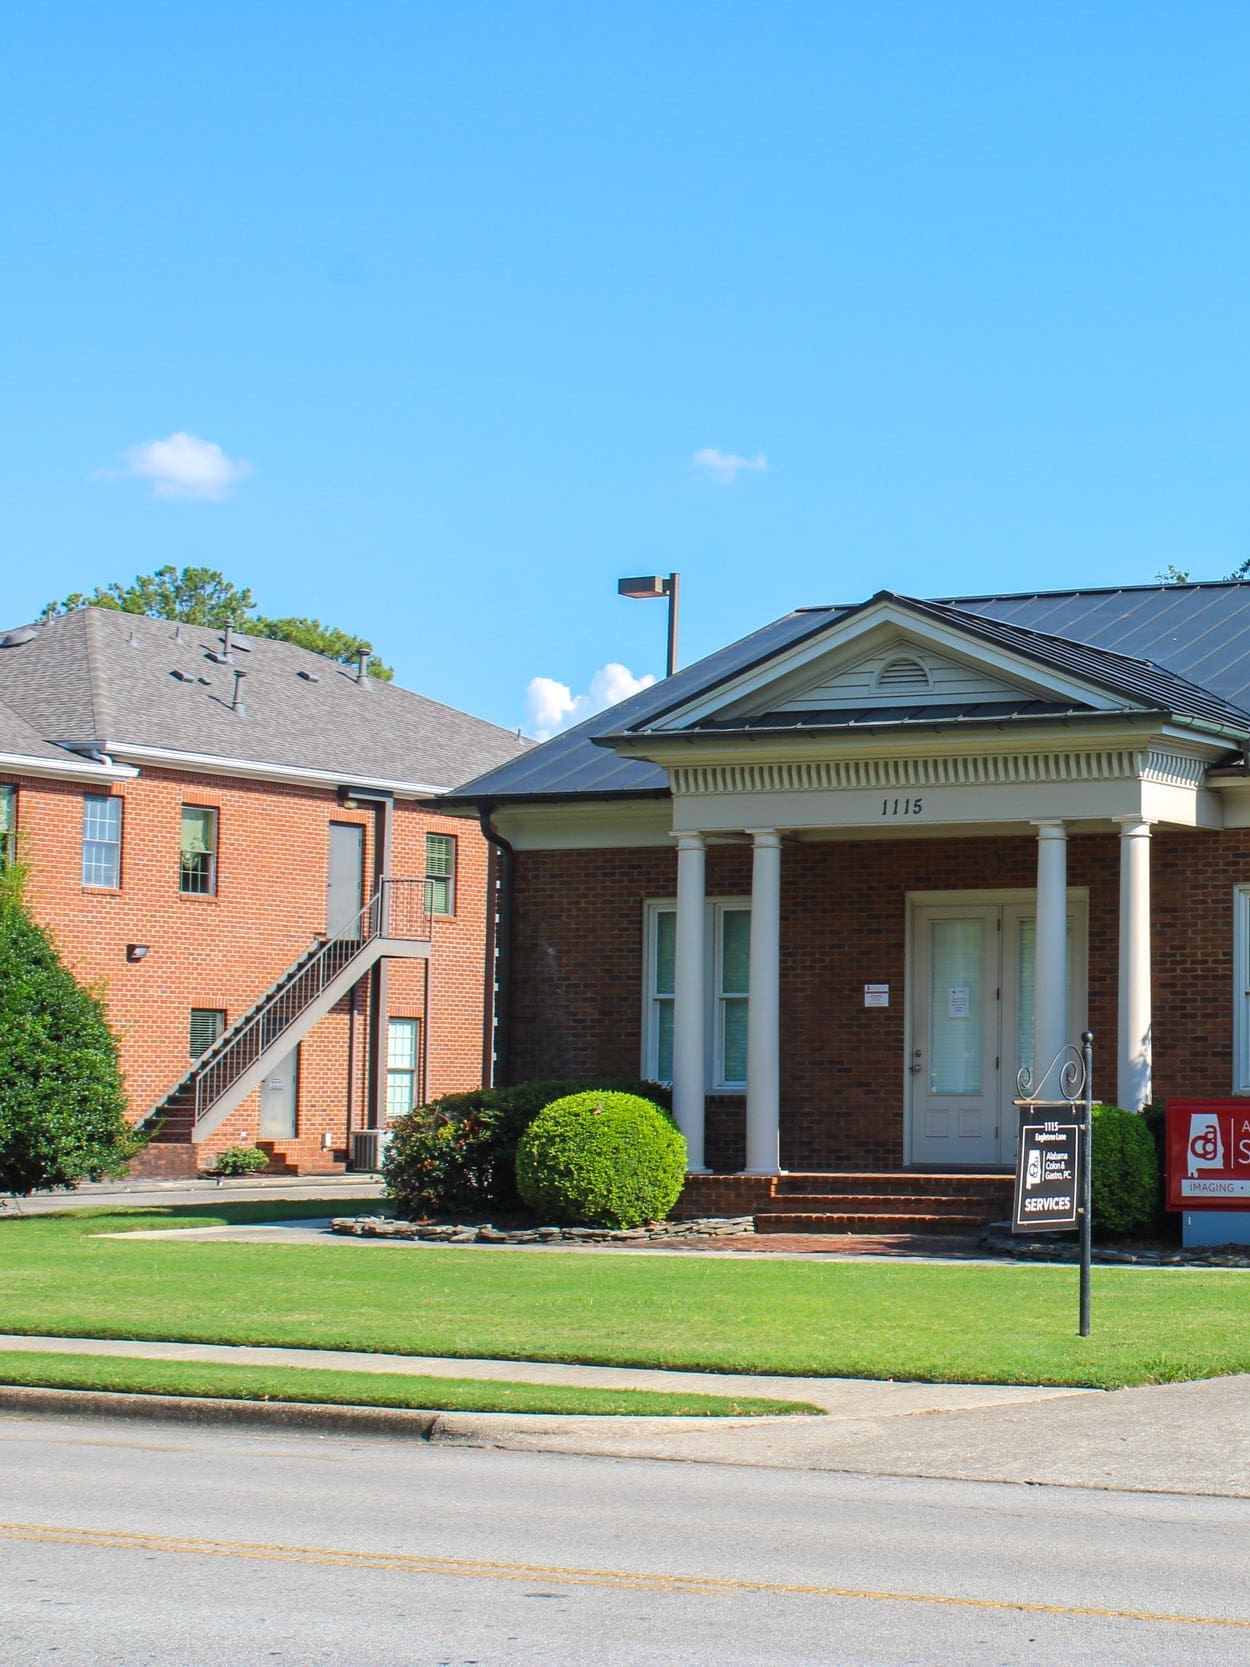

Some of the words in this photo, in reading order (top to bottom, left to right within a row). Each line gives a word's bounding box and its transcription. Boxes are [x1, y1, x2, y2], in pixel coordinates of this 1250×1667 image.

[882, 798, 922, 815] 1115
[1044, 1121, 1059, 1132] 1115
[1045, 1161, 1060, 1170] Colon
[1189, 1183, 1235, 1193] IMAGING
[1024, 1196, 1071, 1212] SERVICES
